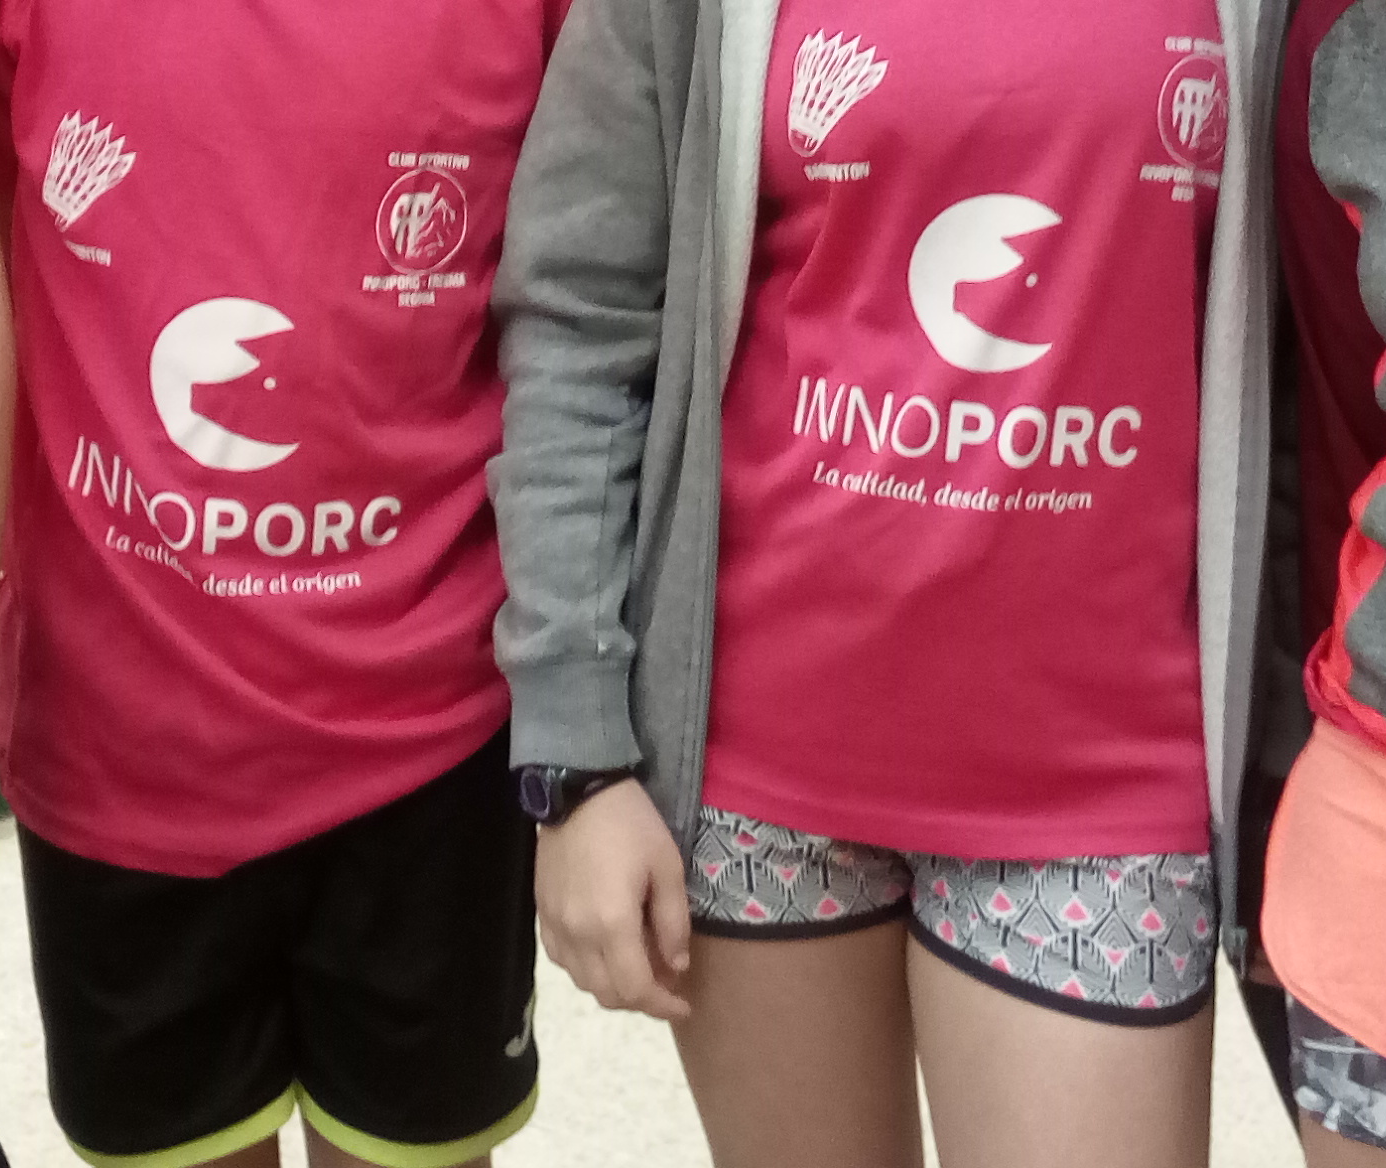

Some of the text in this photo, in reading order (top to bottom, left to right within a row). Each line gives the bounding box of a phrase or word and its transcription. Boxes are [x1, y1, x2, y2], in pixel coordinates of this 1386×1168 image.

[794, 376, 1142, 469] INNOPORC
[813, 461, 1093, 514] La calidad, desde el origen
[106, 526, 130, 553] La
[203, 573, 264, 597] desde
[269, 574, 288, 595] el
[292, 571, 361, 595] origen
